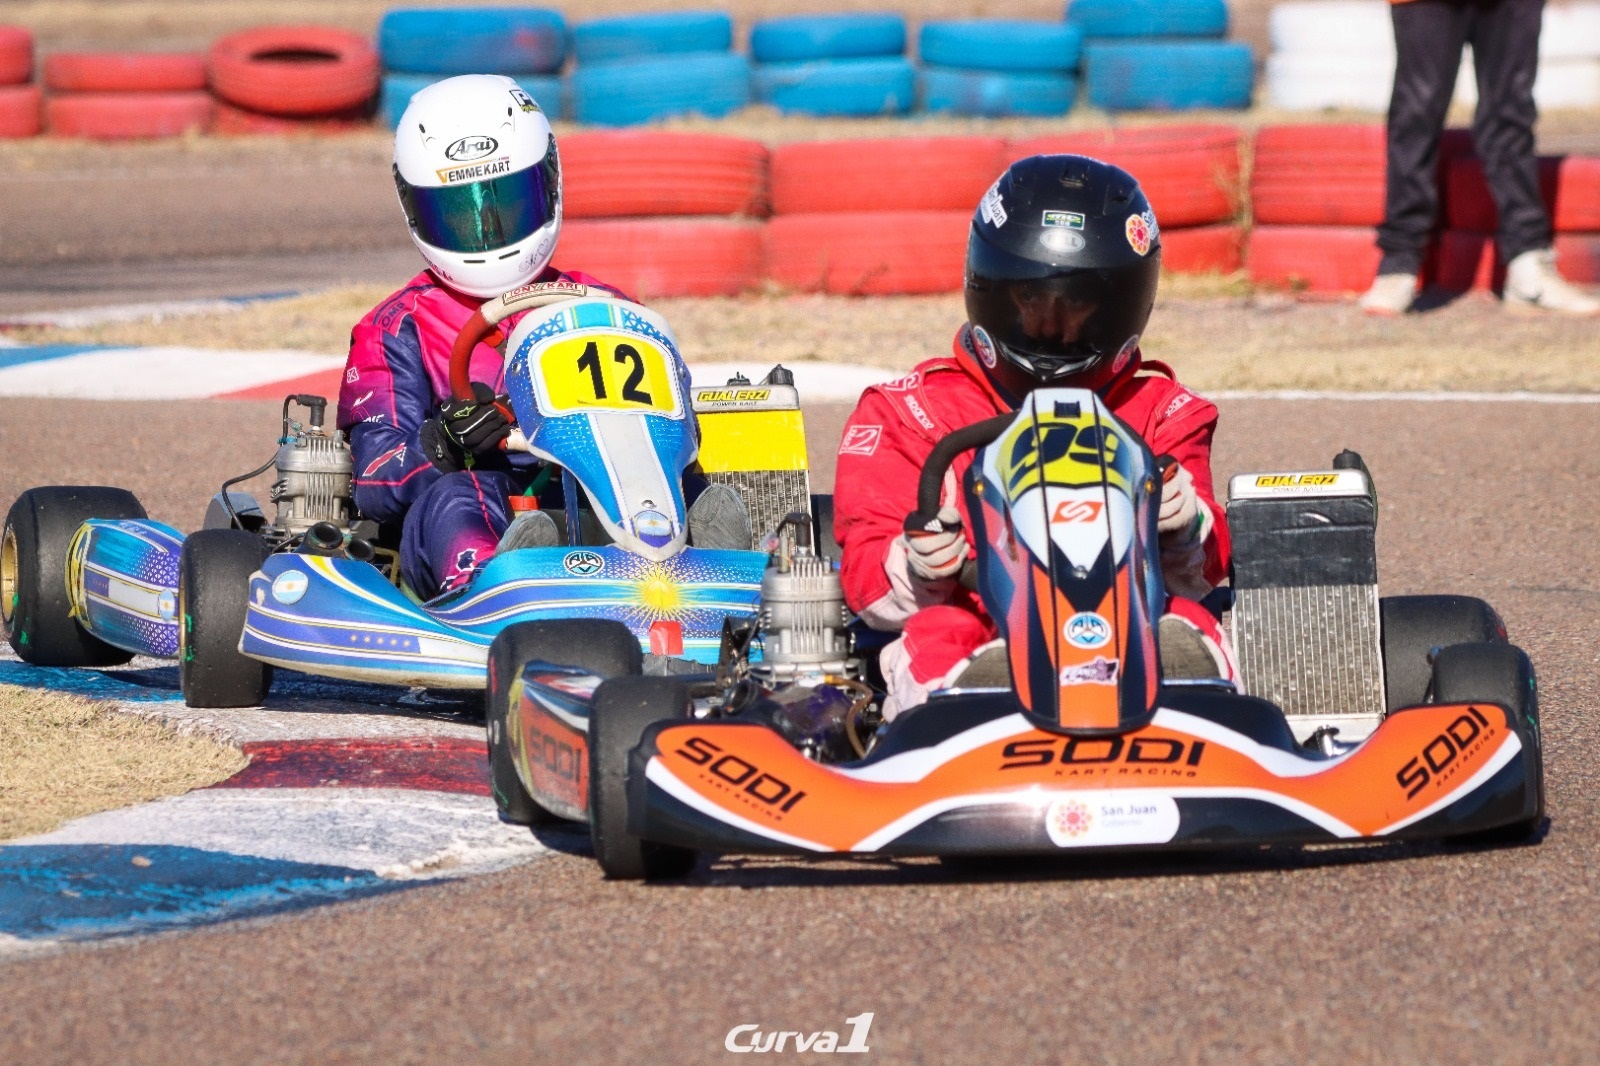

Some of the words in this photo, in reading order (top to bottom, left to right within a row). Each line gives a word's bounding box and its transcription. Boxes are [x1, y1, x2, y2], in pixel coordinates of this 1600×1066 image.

[452, 137, 492, 157] Arai
[381, 302, 406, 328] OMP
[577, 341, 653, 406] 12
[698, 388, 772, 403] GUALERZI
[903, 394, 935, 431] sparco
[1255, 473, 1339, 488] GUALERZI
[529, 726, 582, 785] SODI
[998, 737, 1207, 770] SODI
[1396, 706, 1490, 801] SODI
[674, 736, 807, 814] SODI
[698, 773, 730, 792] KART
[1054, 768, 1110, 776] KART
[1117, 768, 1198, 778] RACING
[1436, 762, 1461, 787] KART
[1100, 806, 1124, 817] San
[1128, 804, 1158, 816] Juan
